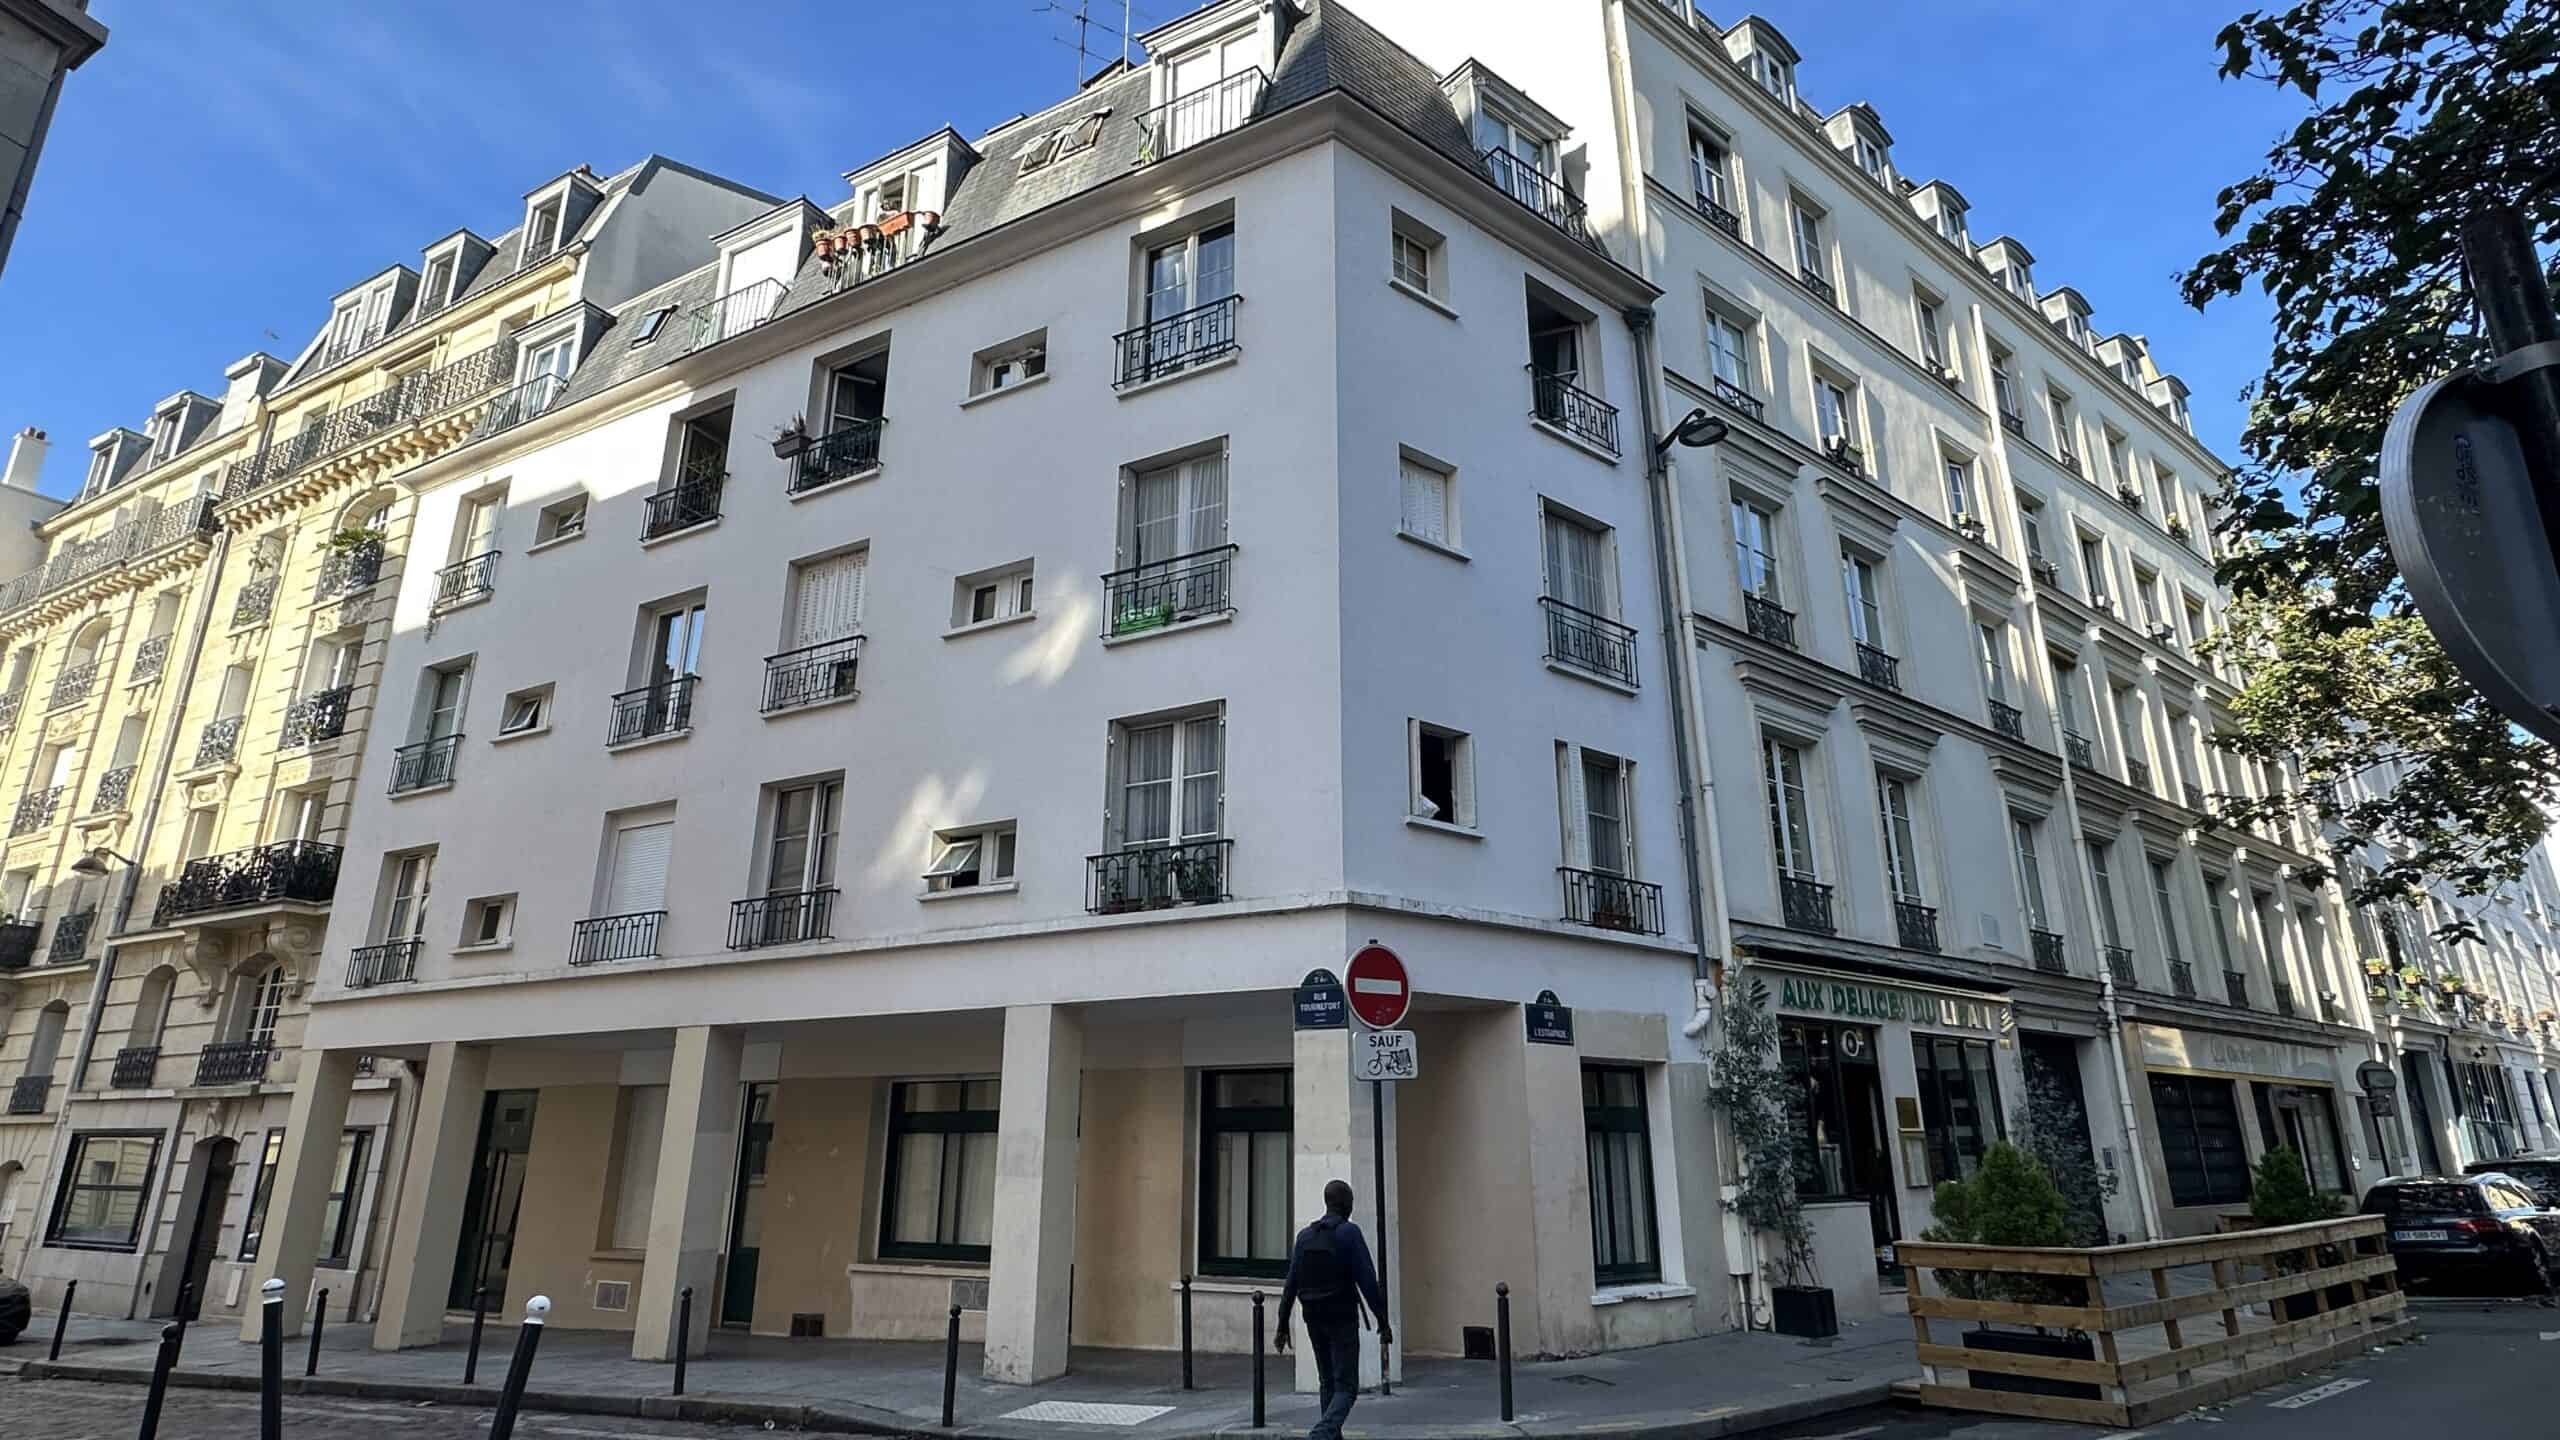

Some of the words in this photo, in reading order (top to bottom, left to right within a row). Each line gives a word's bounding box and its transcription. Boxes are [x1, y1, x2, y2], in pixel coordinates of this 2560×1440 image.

[1780, 978, 1824, 1009] AUX
[1907, 992, 1937, 1023] DU
[1368, 1035, 1402, 1047] SAUF
